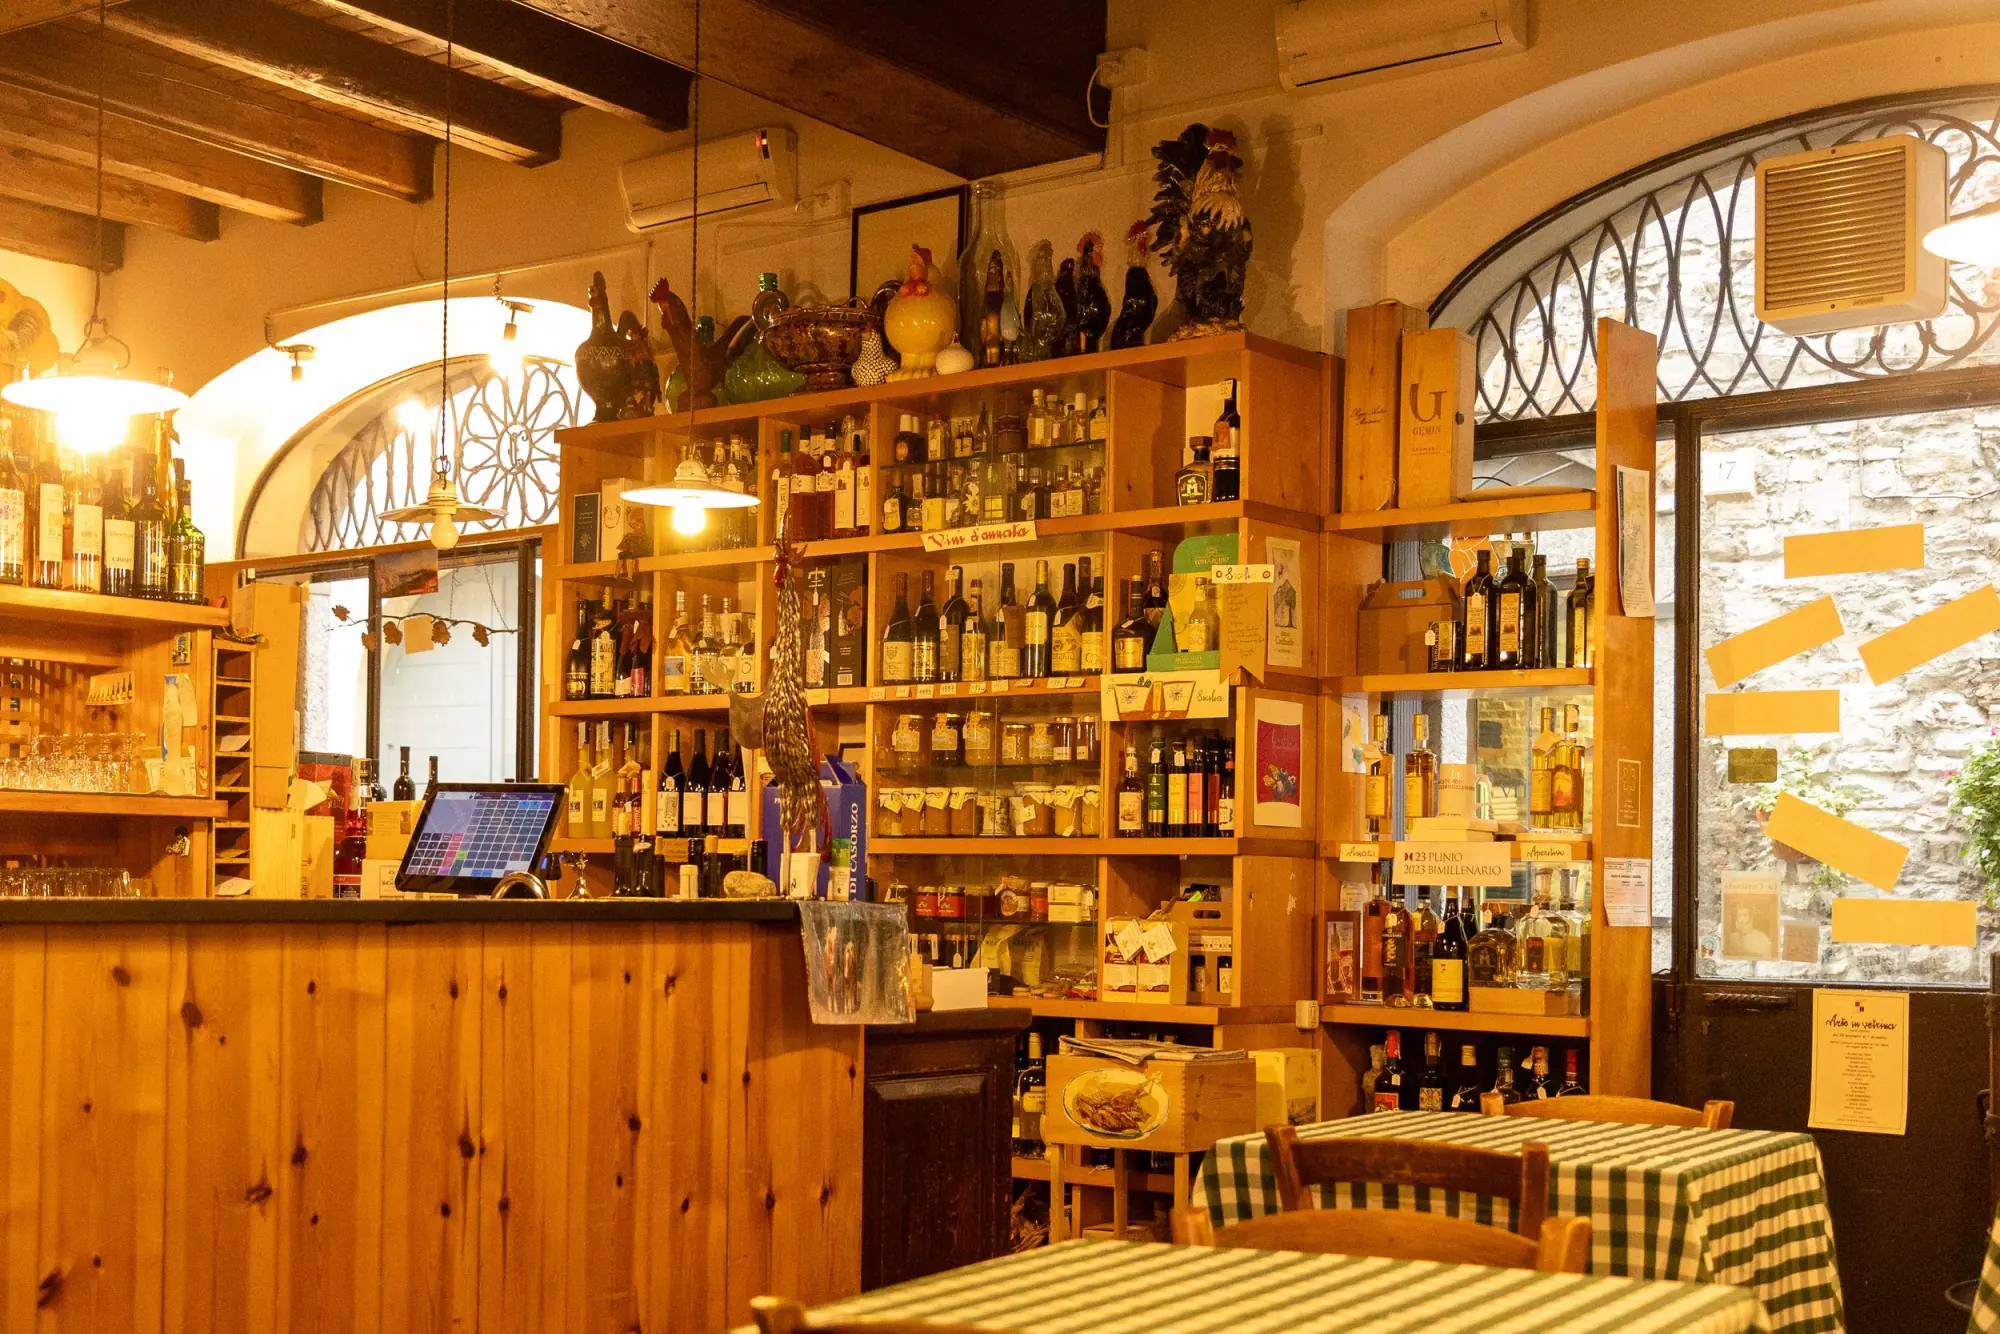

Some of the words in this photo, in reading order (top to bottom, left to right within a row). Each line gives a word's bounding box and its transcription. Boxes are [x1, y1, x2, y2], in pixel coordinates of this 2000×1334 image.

[1410, 383, 1448, 422] G
[928, 533, 965, 548] Vini
[970, 524, 1029, 543] d'annata
[850, 802, 859, 873] CASORZO
[1414, 852, 1426, 862] 23
[1428, 852, 1463, 862] PLINIO
[1404, 864, 1426, 875] 2023
[1428, 865, 1502, 876] BIMILLENARIO
[850, 877, 857, 894] DI
[1826, 1014, 1848, 1028] Arte
[1851, 1016, 1861, 1028] in
[1862, 1018, 1897, 1031] vetrina
